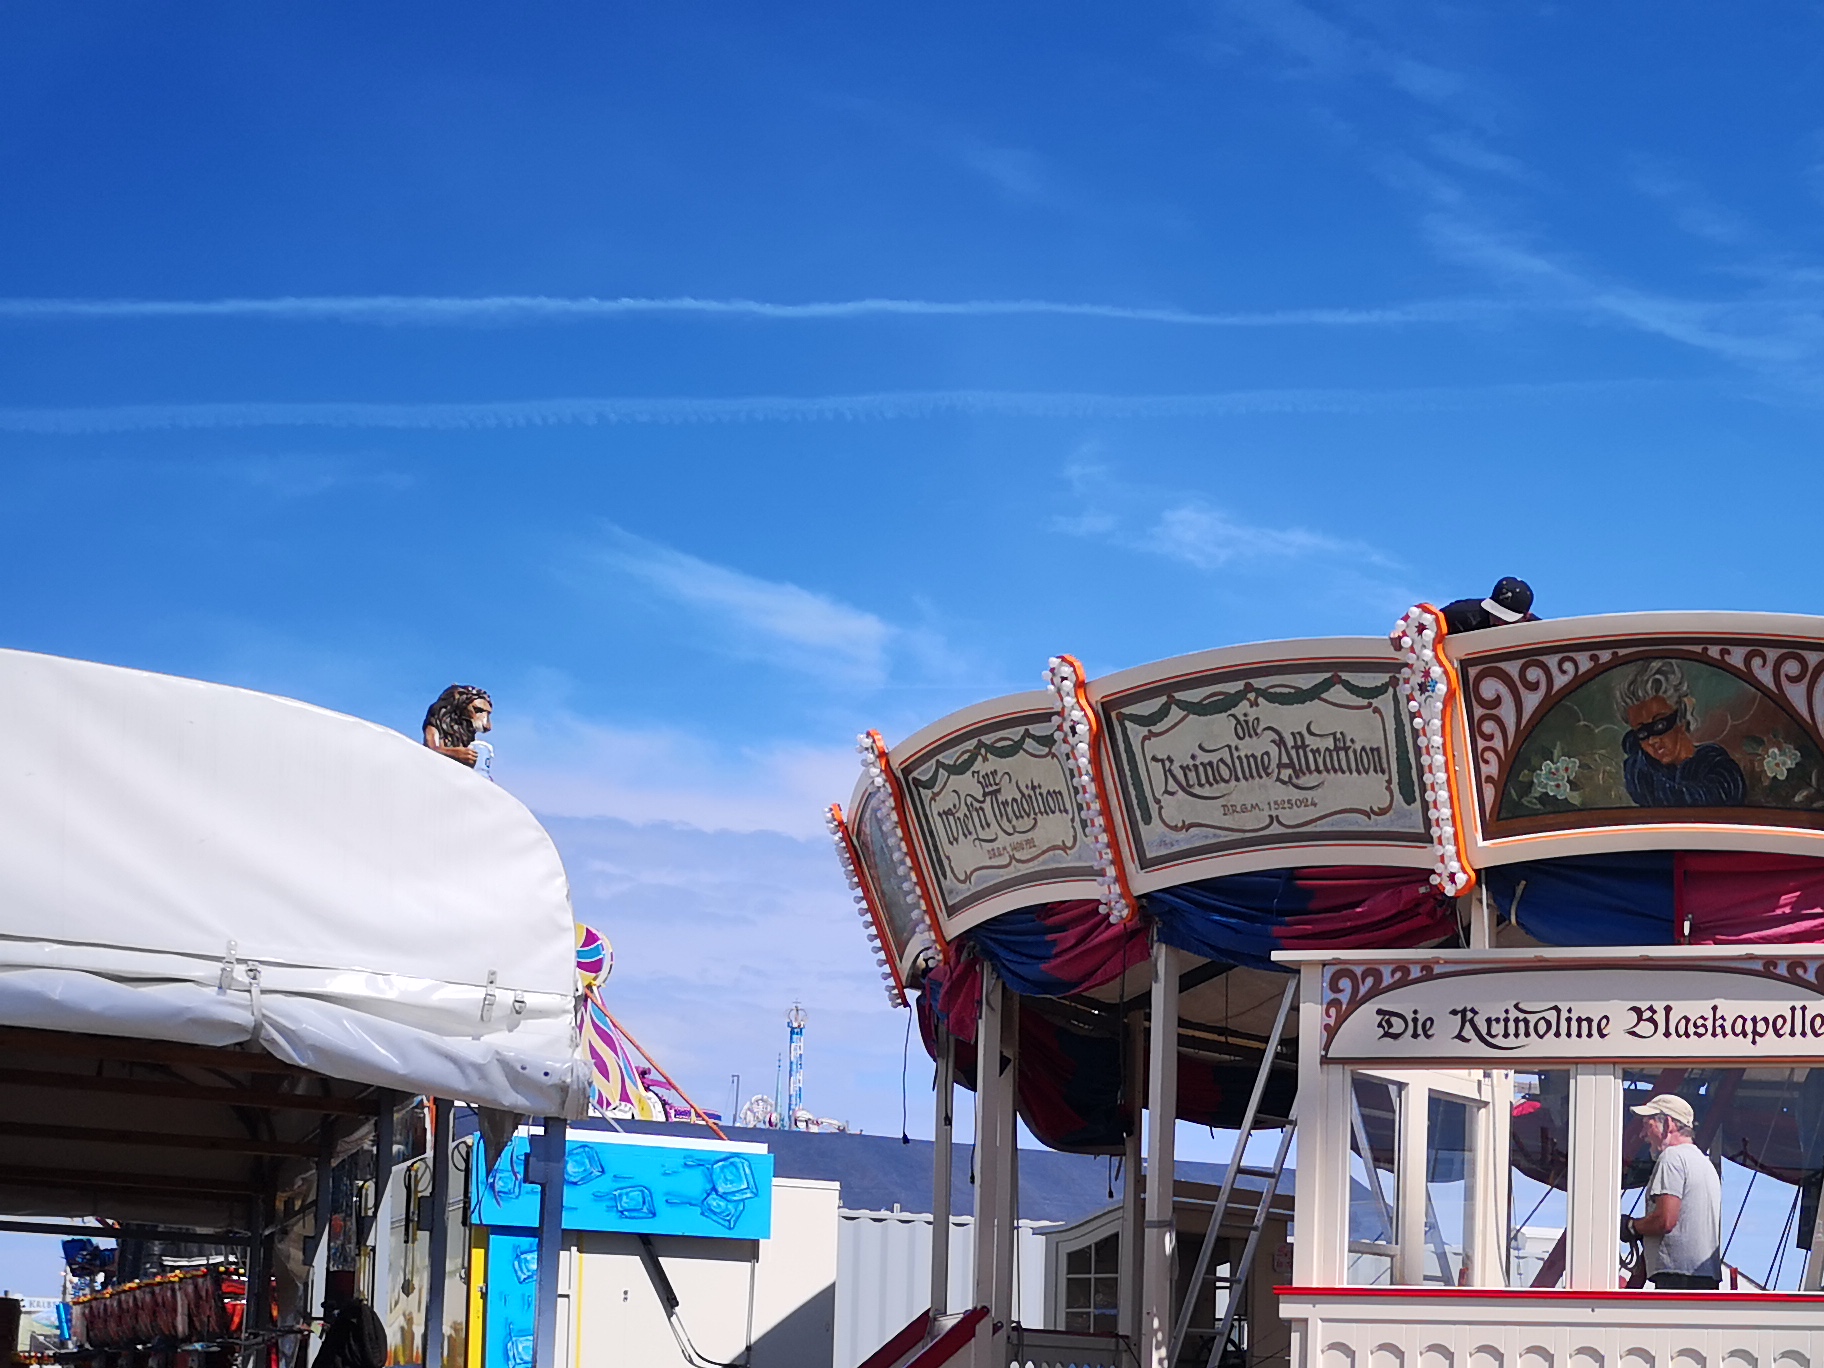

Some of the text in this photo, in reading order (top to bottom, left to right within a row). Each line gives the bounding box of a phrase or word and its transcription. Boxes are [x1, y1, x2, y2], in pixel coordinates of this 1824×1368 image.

[1227, 712, 1261, 740] die
[1151, 743, 1274, 800] Krinoline
[984, 778, 1070, 836] Tradition
[1376, 1008, 1435, 1040] Die
[1449, 1002, 1610, 1050] Krinoline
